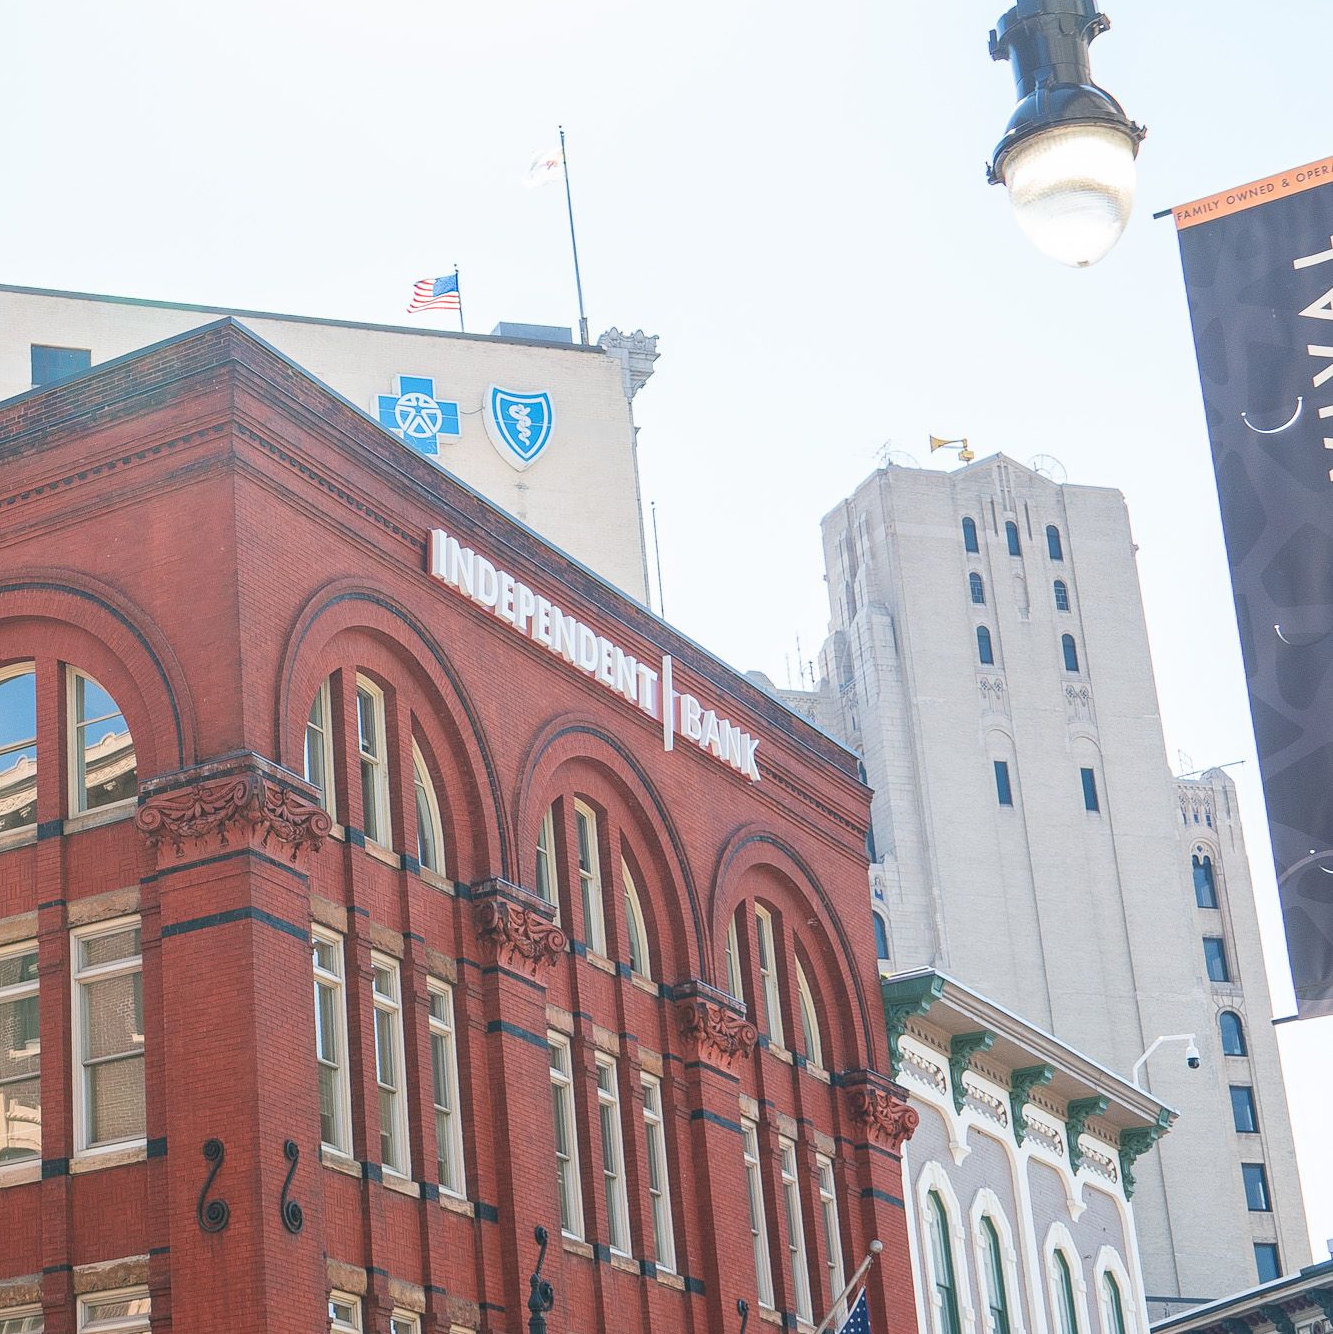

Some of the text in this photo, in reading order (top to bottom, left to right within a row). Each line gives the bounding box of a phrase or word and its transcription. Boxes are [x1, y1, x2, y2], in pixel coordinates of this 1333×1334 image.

[1176, 199, 1220, 221] FAMILY
[1226, 183, 1275, 205] OWNED
[1281, 178, 1290, 188] &
[431, 528, 761, 782] INDEPENDENT BANK
